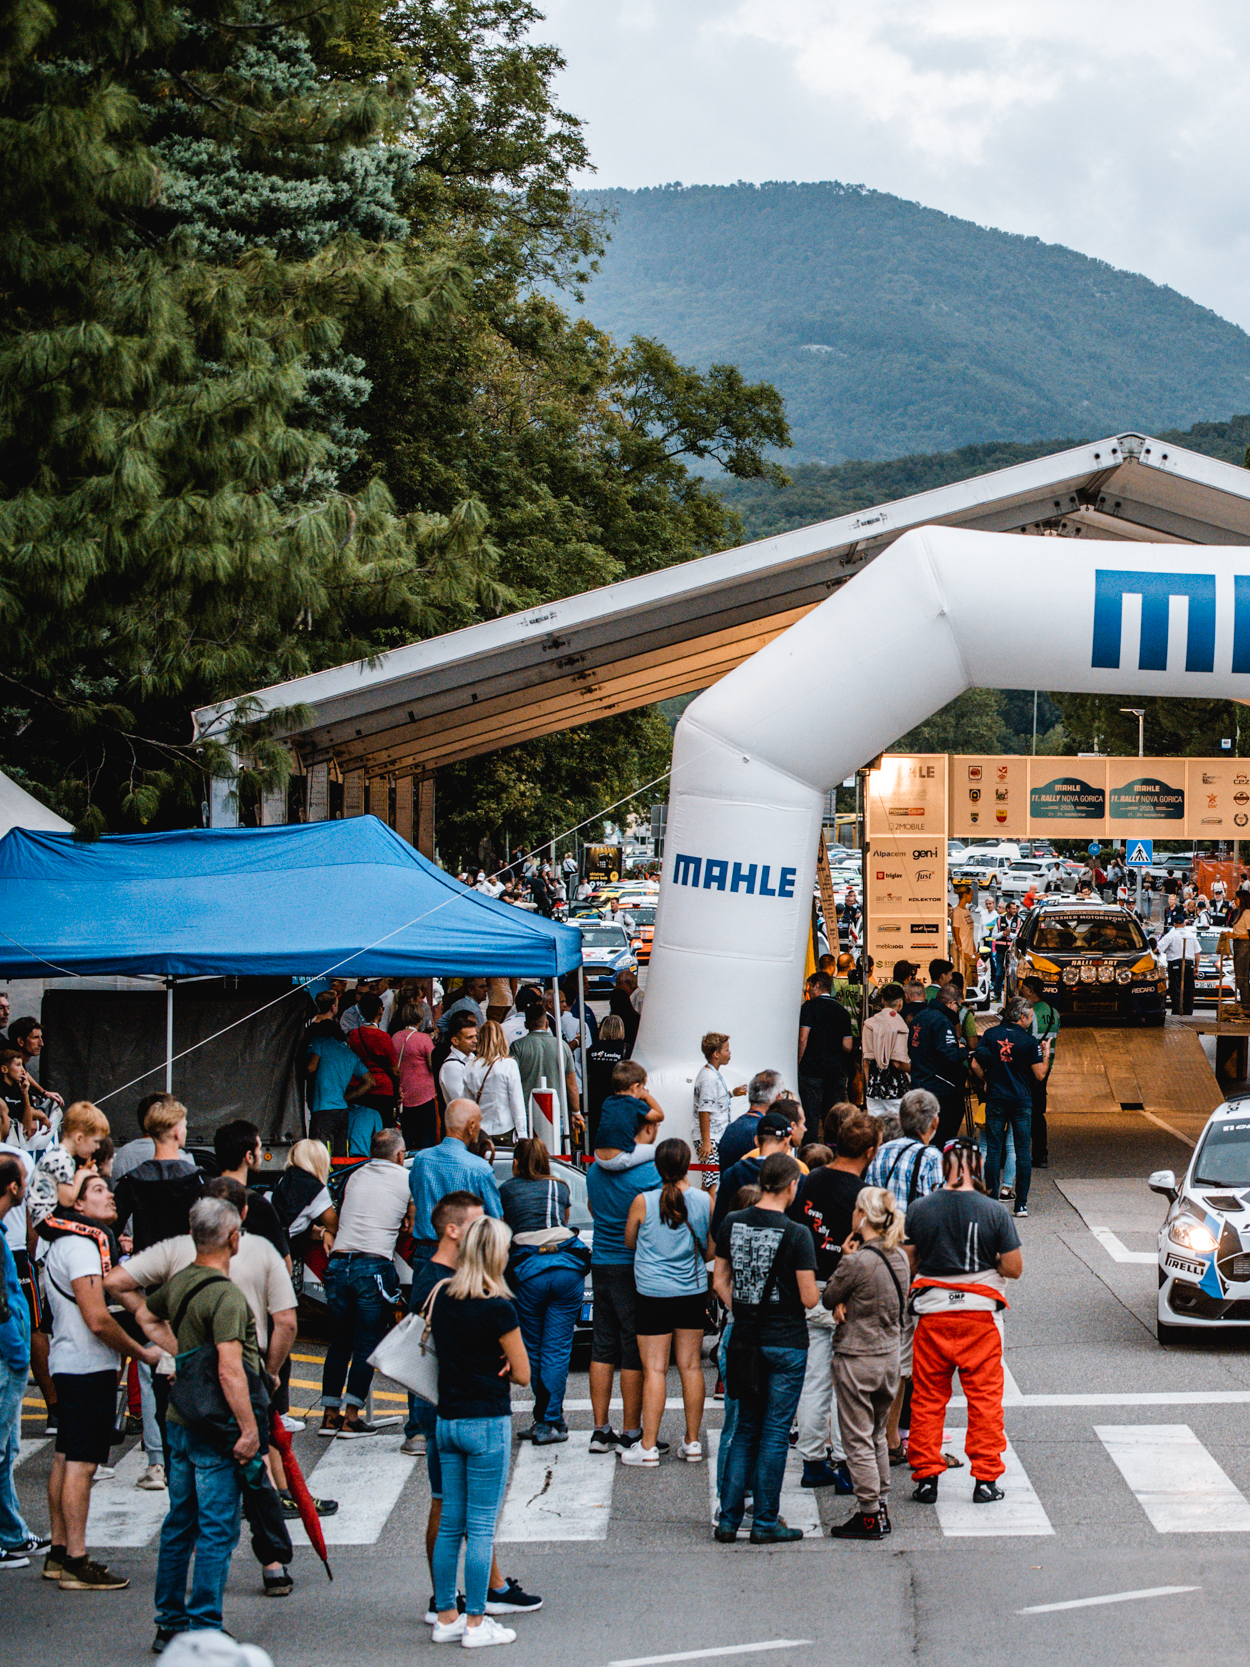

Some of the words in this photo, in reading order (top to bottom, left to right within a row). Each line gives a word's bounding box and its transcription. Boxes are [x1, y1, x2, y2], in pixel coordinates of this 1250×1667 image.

[1054, 784, 1081, 792] MAHLE
[1061, 795, 1079, 803] NOVA
[1080, 795, 1104, 803] GORICA
[1120, 795, 1140, 803] RALLY
[1140, 795, 1157, 803] NOVA
[1158, 795, 1183, 803] GORICA
[895, 823, 925, 831] 2MOBILE
[873, 850, 906, 858] Alpacem
[912, 847, 938, 860] gen-i
[672, 853, 797, 898] MAHLE
[885, 872, 903, 880] triglav
[915, 871, 932, 882] Just
[1131, 986, 1155, 994] RECARO
[813, 1217, 830, 1237] Rally
[1165, 1251, 1205, 1276] PIRELLI
[948, 1293, 965, 1301] OMP
